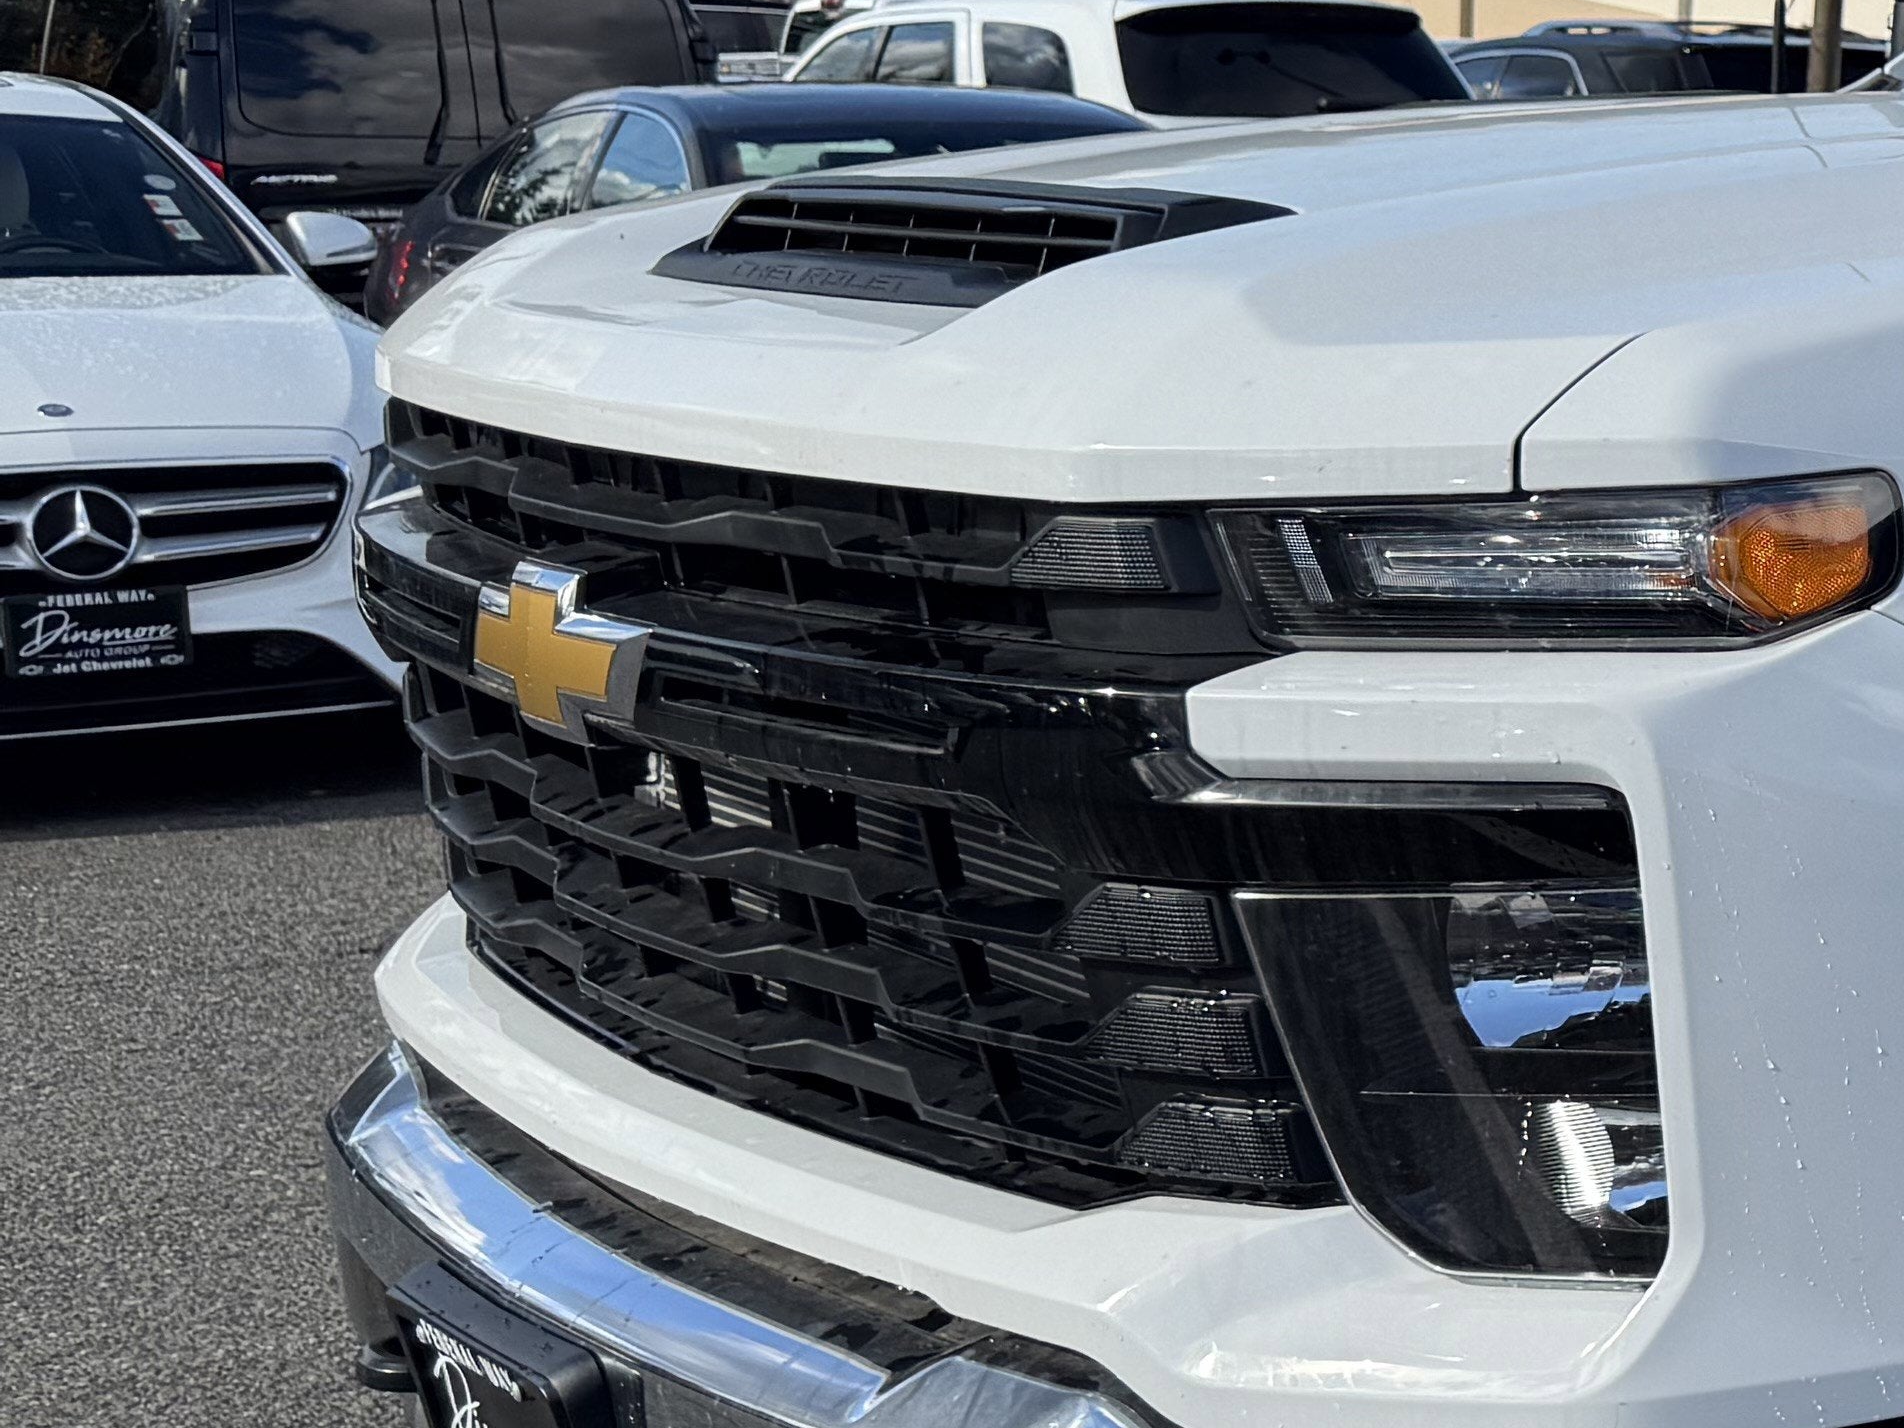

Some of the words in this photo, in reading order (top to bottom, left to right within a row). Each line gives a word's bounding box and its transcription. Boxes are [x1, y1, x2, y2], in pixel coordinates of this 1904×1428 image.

[734, 261, 920, 293] CHEVROLET
[47, 591, 113, 607] FEDERAL
[116, 589, 146, 603] WAY
[19, 609, 178, 658] Dinsmore
[64, 649, 100, 659] AUTO
[104, 643, 150, 656] GROUP
[52, 662, 78, 674] Jet
[80, 656, 153, 672] Chevrolet
